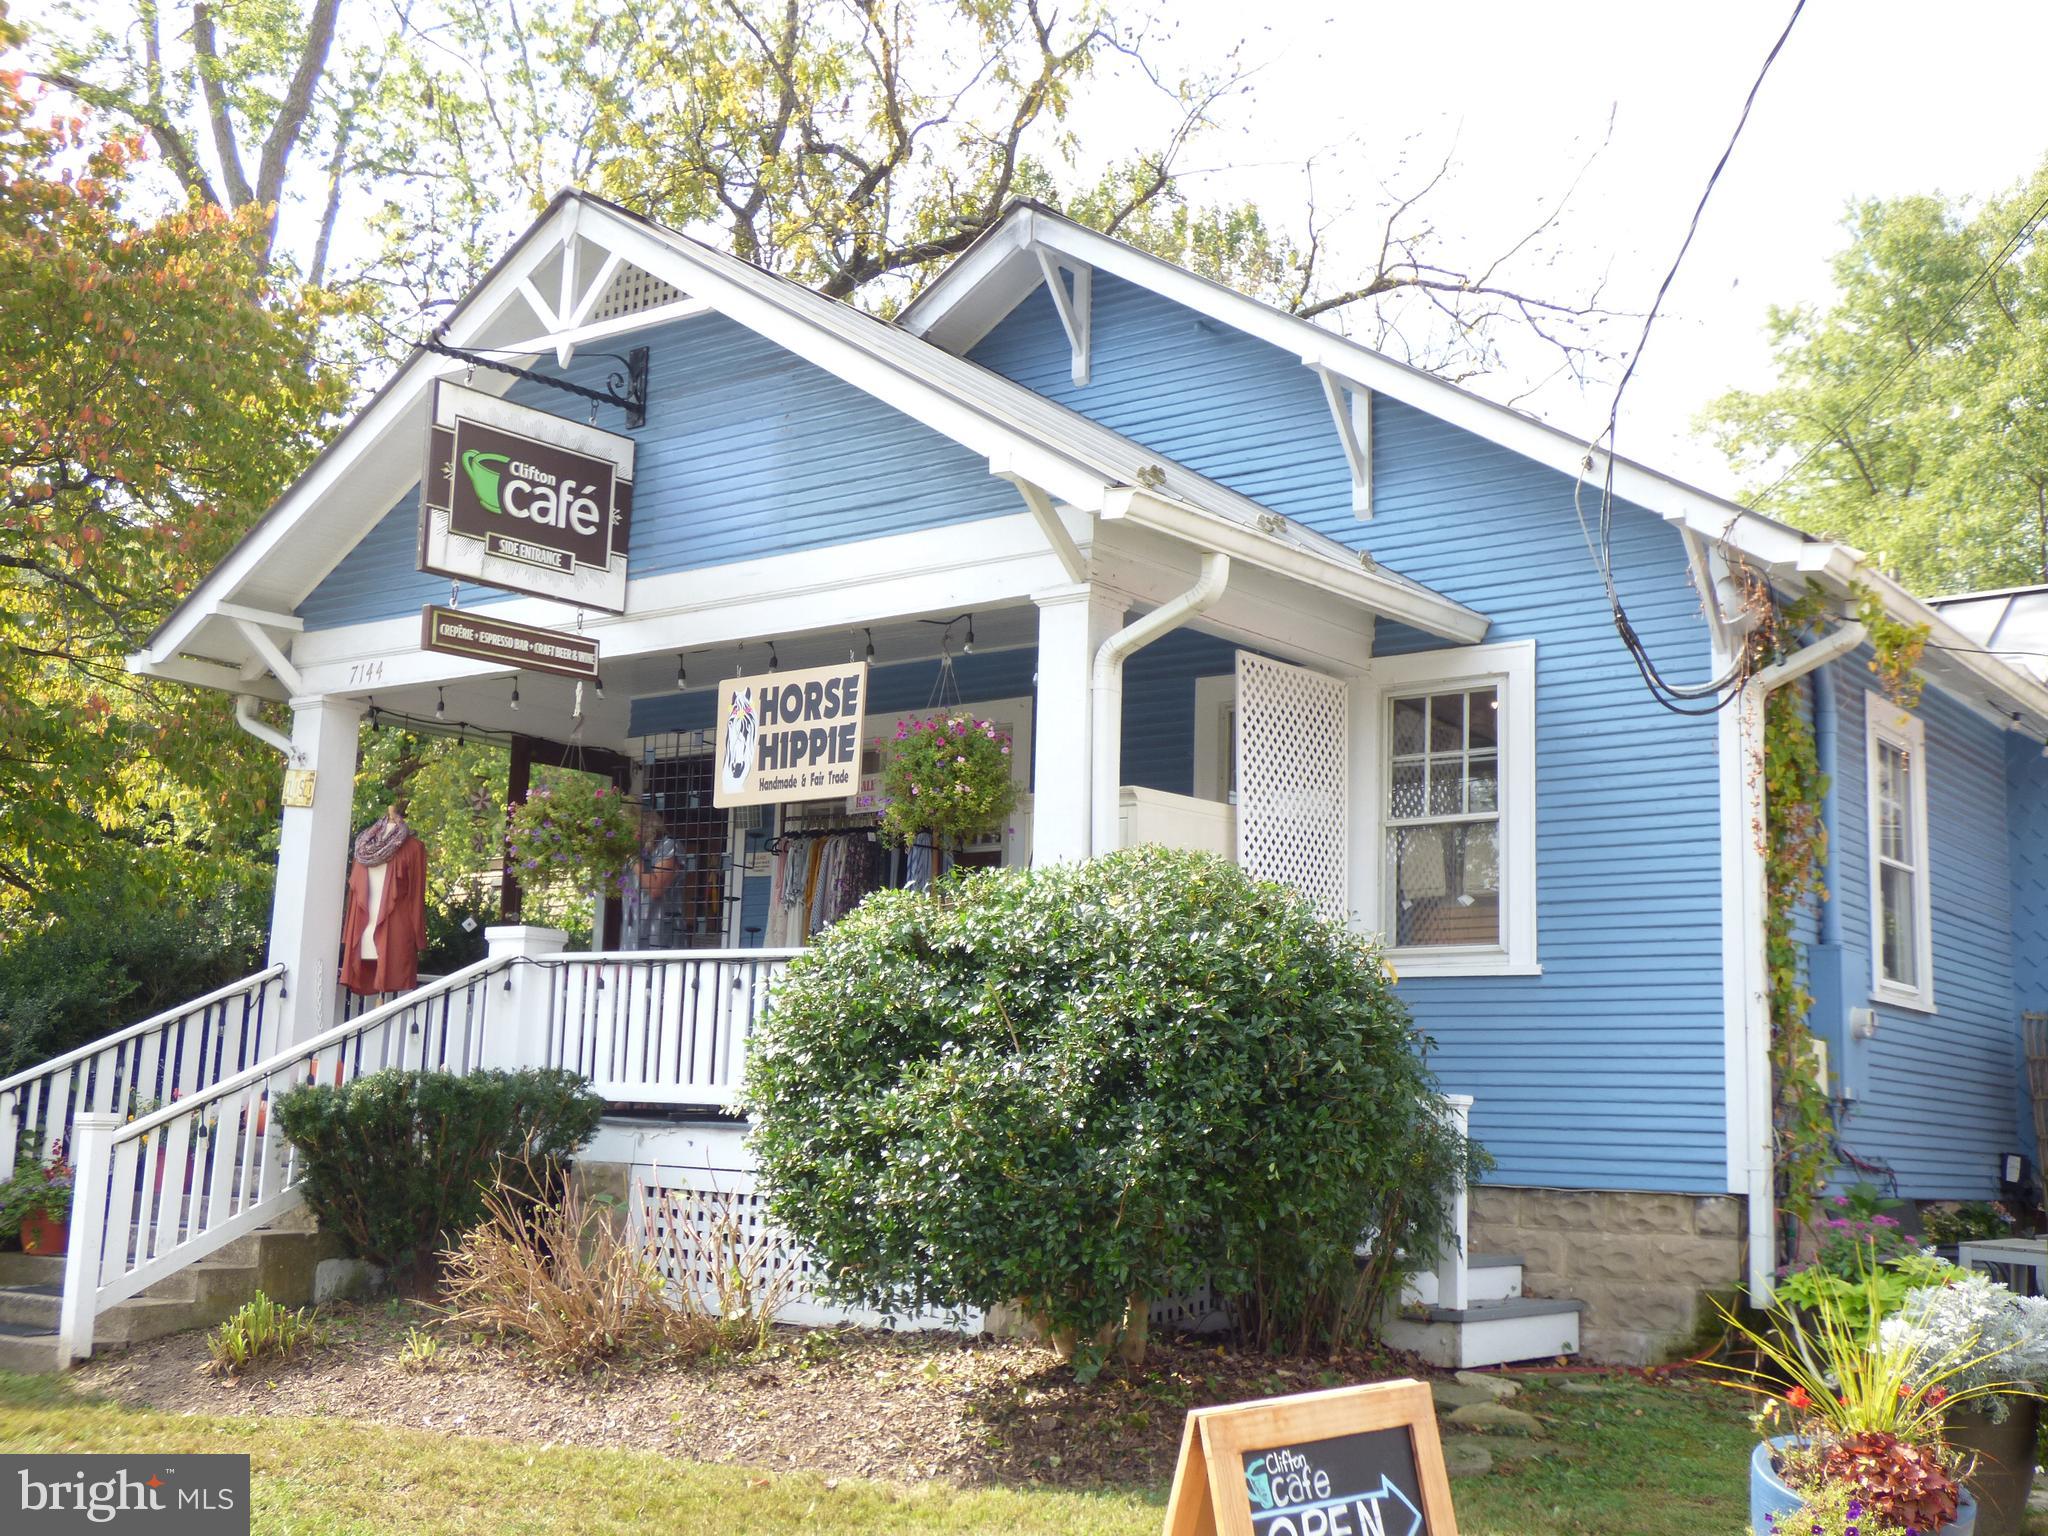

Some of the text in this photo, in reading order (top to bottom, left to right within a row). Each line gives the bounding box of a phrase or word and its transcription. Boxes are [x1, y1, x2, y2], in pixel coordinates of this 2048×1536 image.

[509, 461, 556, 486] Clifton
[503, 479, 600, 536] café
[498, 539, 562, 567] SIDE ENTRANCE
[478, 631, 514, 648] ESPRESSO
[514, 638, 529, 652] BAR
[533, 642, 555, 657] CRAFT
[555, 648, 572, 660] BEER
[578, 652, 596, 665] WINE
[350, 660, 383, 685] 7144
[759, 674, 860, 727] HORSE
[758, 722, 857, 771] HIPPIE
[759, 769, 849, 791] Handmade & Fair Trade
[1266, 1450, 1307, 1475] Clifton
